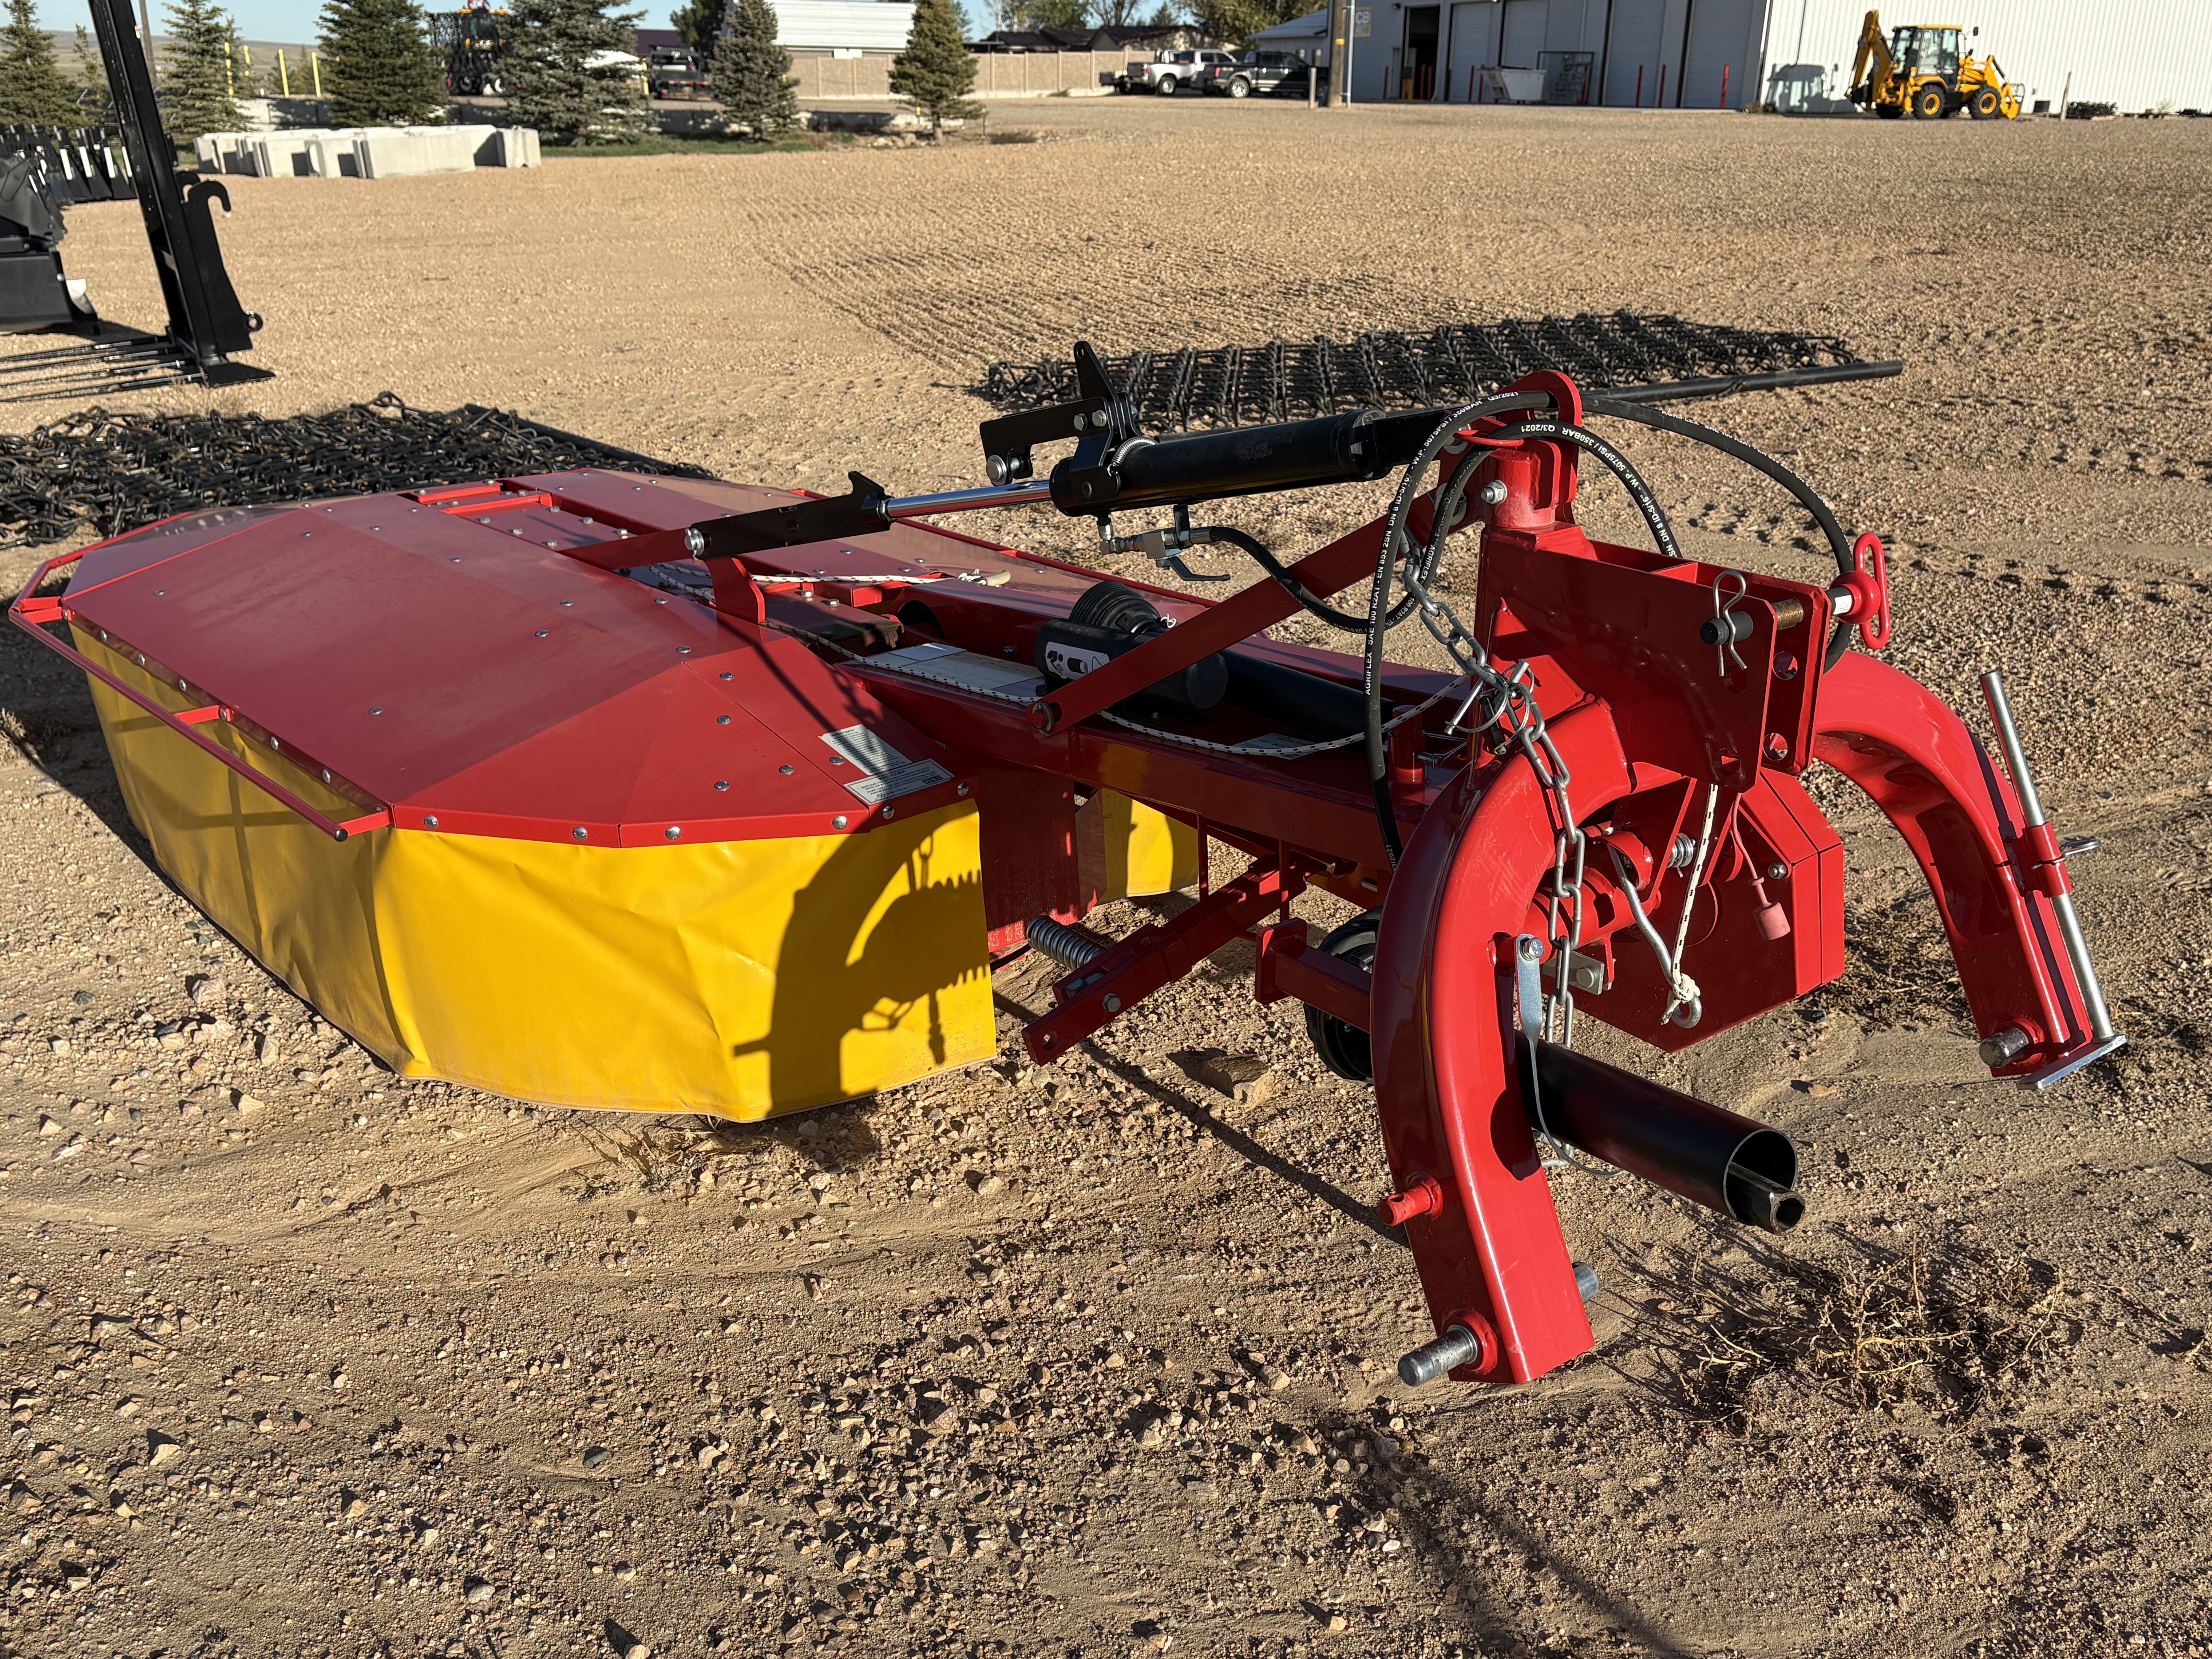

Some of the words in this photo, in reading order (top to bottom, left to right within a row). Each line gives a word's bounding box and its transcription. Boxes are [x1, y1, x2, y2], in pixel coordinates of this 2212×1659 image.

[1355, 11, 1370, 24] CB
[1487, 392, 1519, 401] Q3/2021
[1521, 424, 1556, 433] Q3/2021
[1562, 427, 1595, 446] 350BAR
[1597, 445, 1626, 471] 5075PSI
[1388, 513, 1396, 526] DN
[1383, 531, 1392, 548] 2SN
[1659, 529, 1670, 542] DN
[1379, 550, 1387, 565] 853
[1420, 544, 1436, 580] AGRIFLEX
[1376, 567, 1384, 579] EN
[1371, 586, 1380, 609] R2AT
[1395, 606, 1409, 620] R2AT
